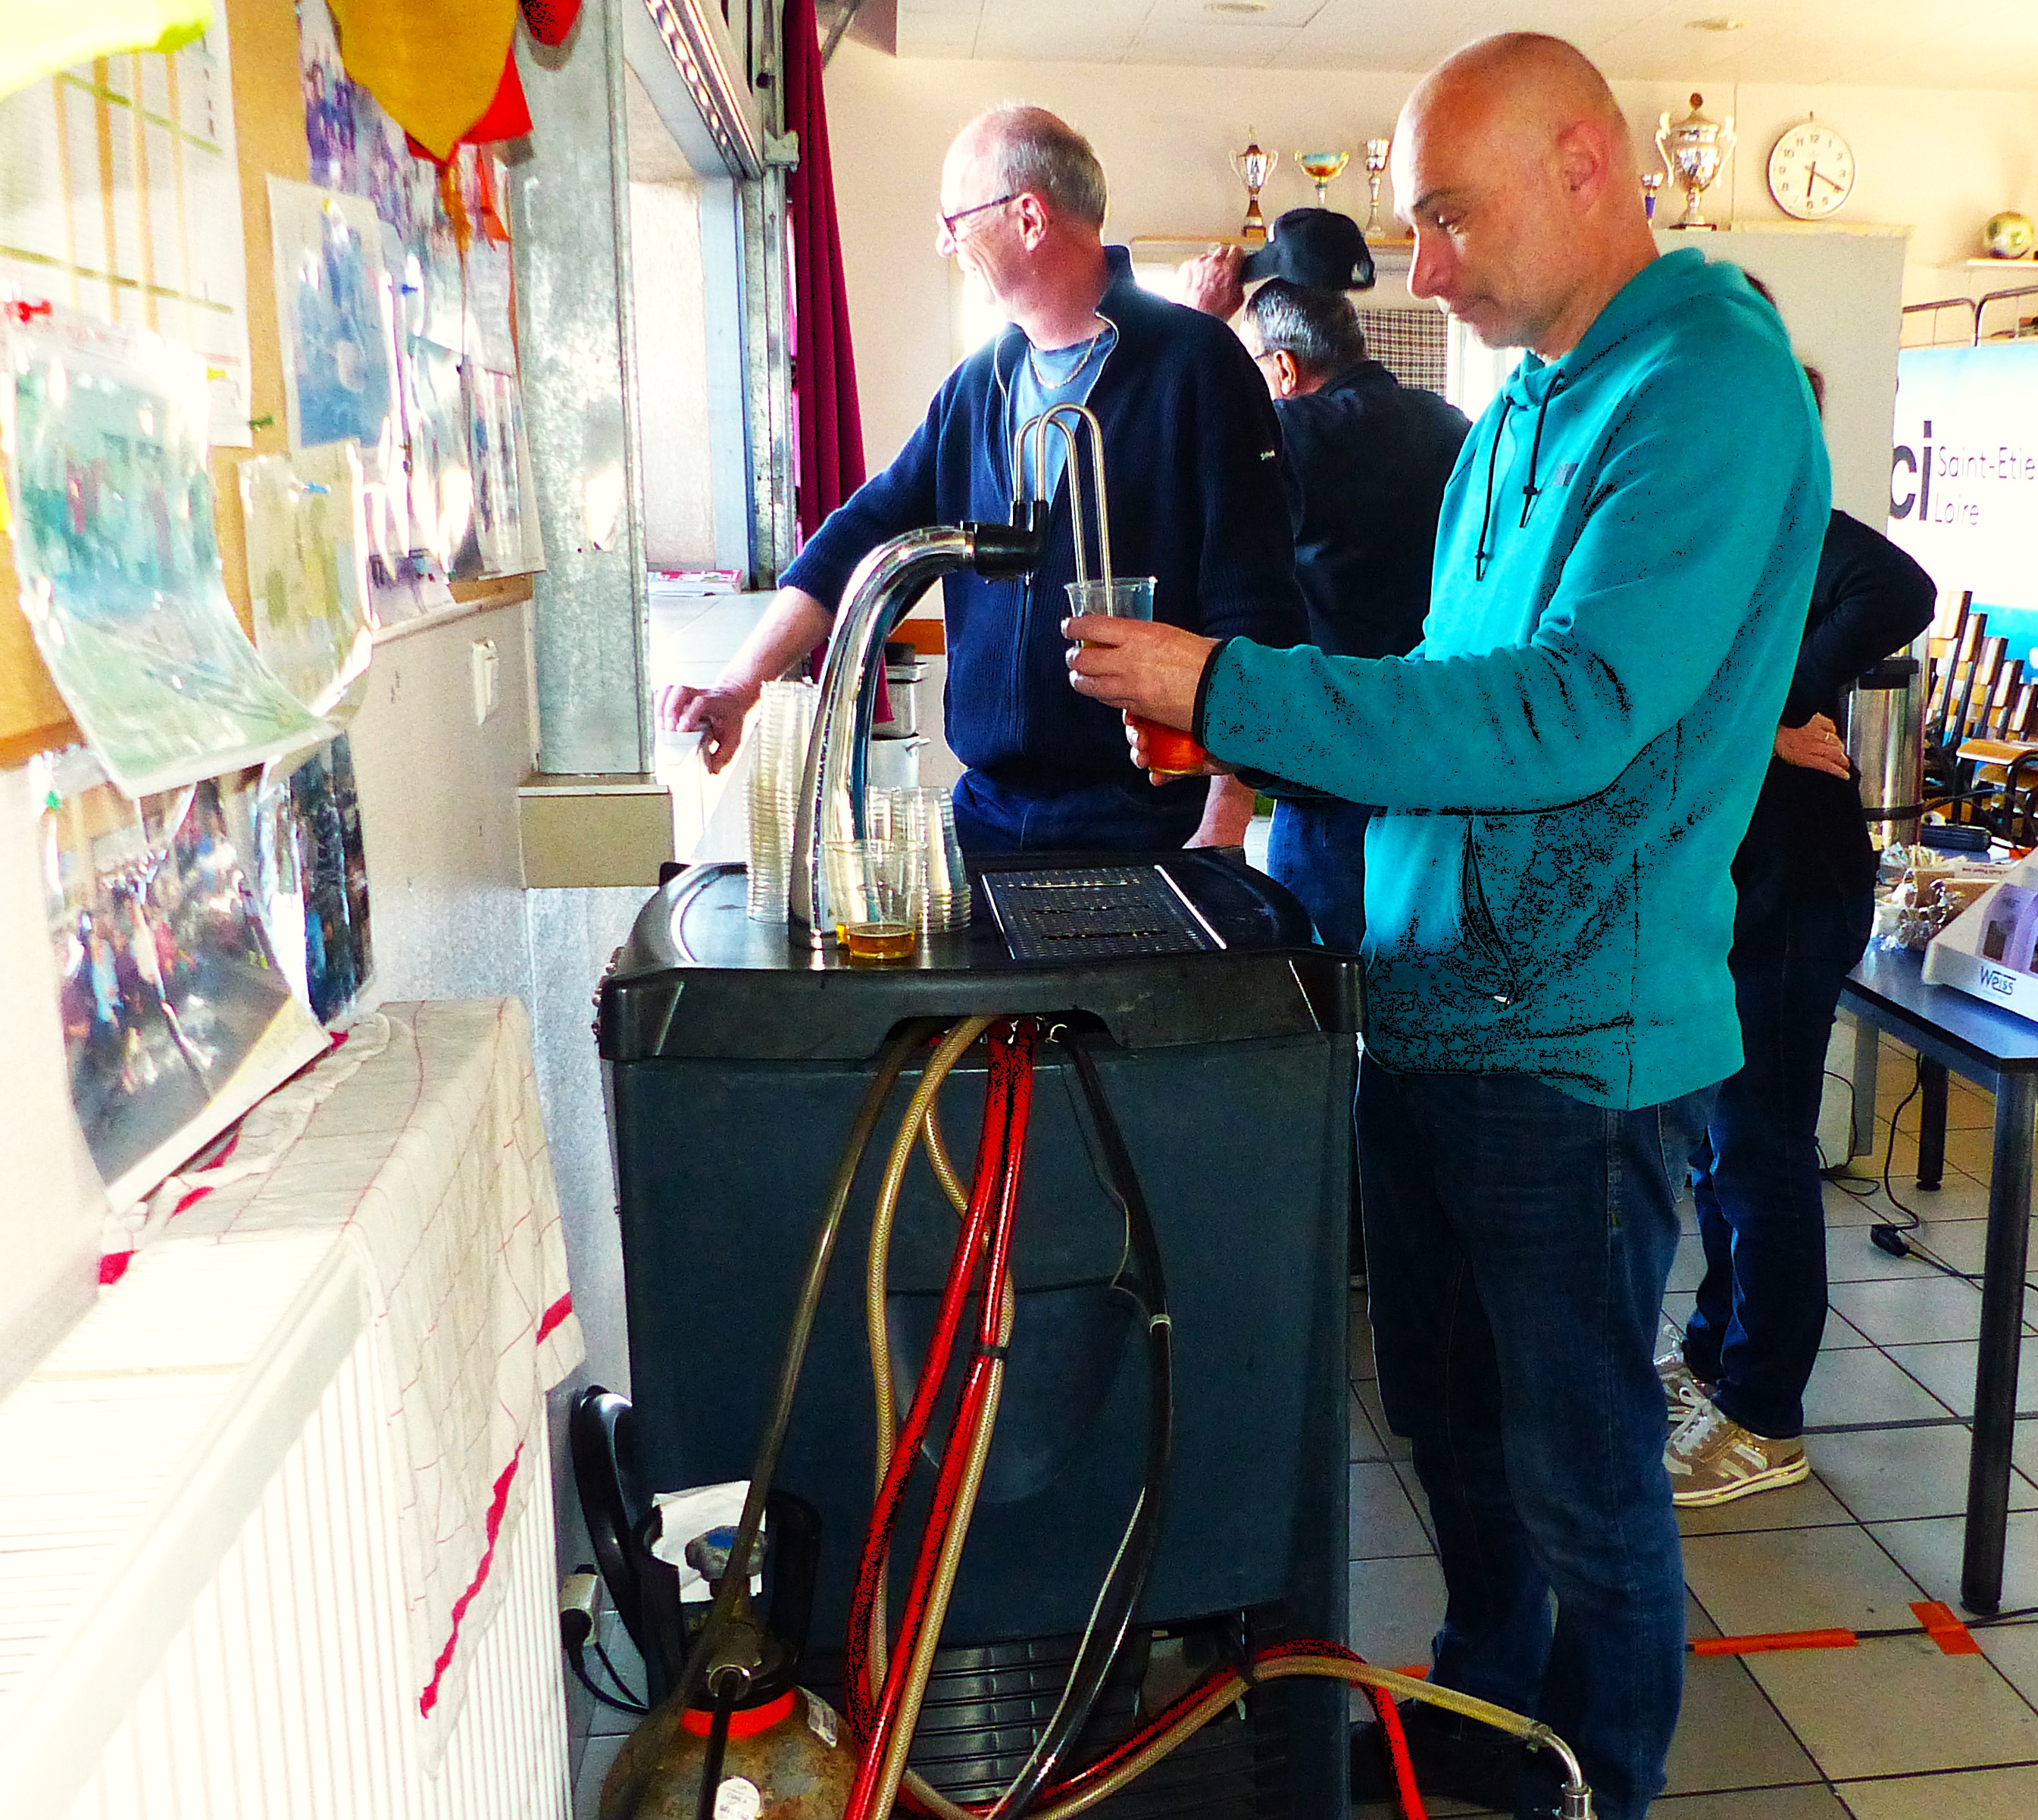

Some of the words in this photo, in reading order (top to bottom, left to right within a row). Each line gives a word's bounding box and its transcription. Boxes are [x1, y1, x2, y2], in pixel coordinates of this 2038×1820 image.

[1796, 138, 1803, 147] 11
[1810, 134, 1819, 143] 12
[1783, 149, 1795, 158] 10
[1836, 152, 1843, 161] 2
[1778, 165, 1786, 175] 9
[1839, 170, 1846, 178] 3
[1781, 183, 1789, 192] 8
[1806, 200, 1814, 210] 6
[1937, 446, 2035, 480] Saint-Etie
[1934, 492, 1979, 525] Loire
[1980, 965, 2017, 996] Weiss
